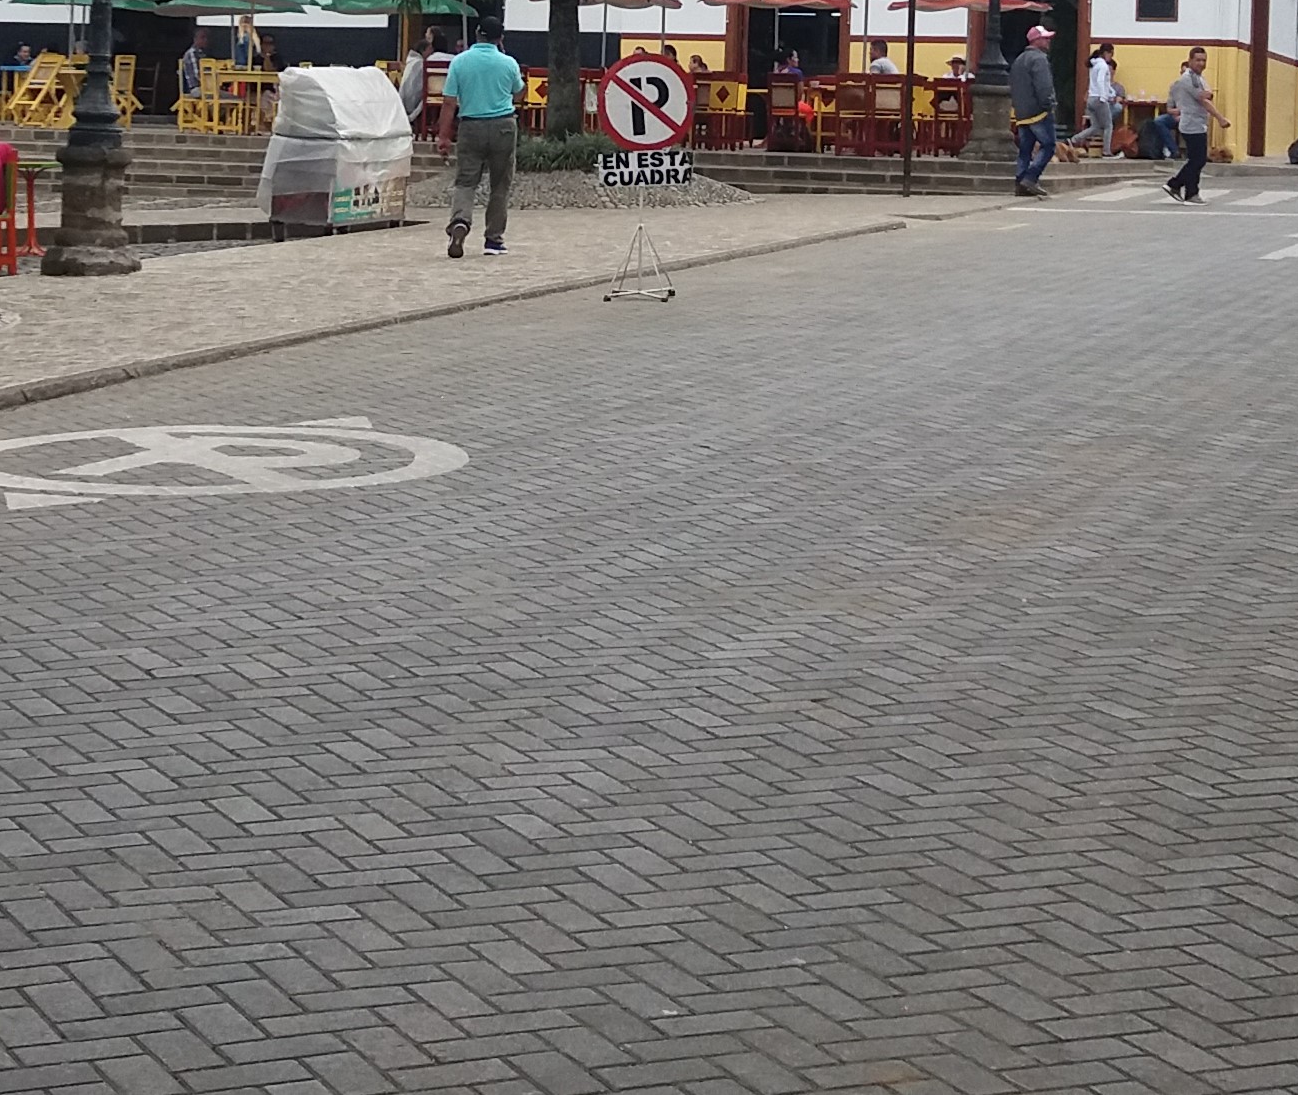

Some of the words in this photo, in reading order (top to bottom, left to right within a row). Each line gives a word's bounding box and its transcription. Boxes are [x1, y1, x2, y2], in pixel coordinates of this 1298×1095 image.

[602, 151, 630, 170] EN
[637, 150, 693, 169] ESTA
[603, 167, 692, 187] CUADRA
